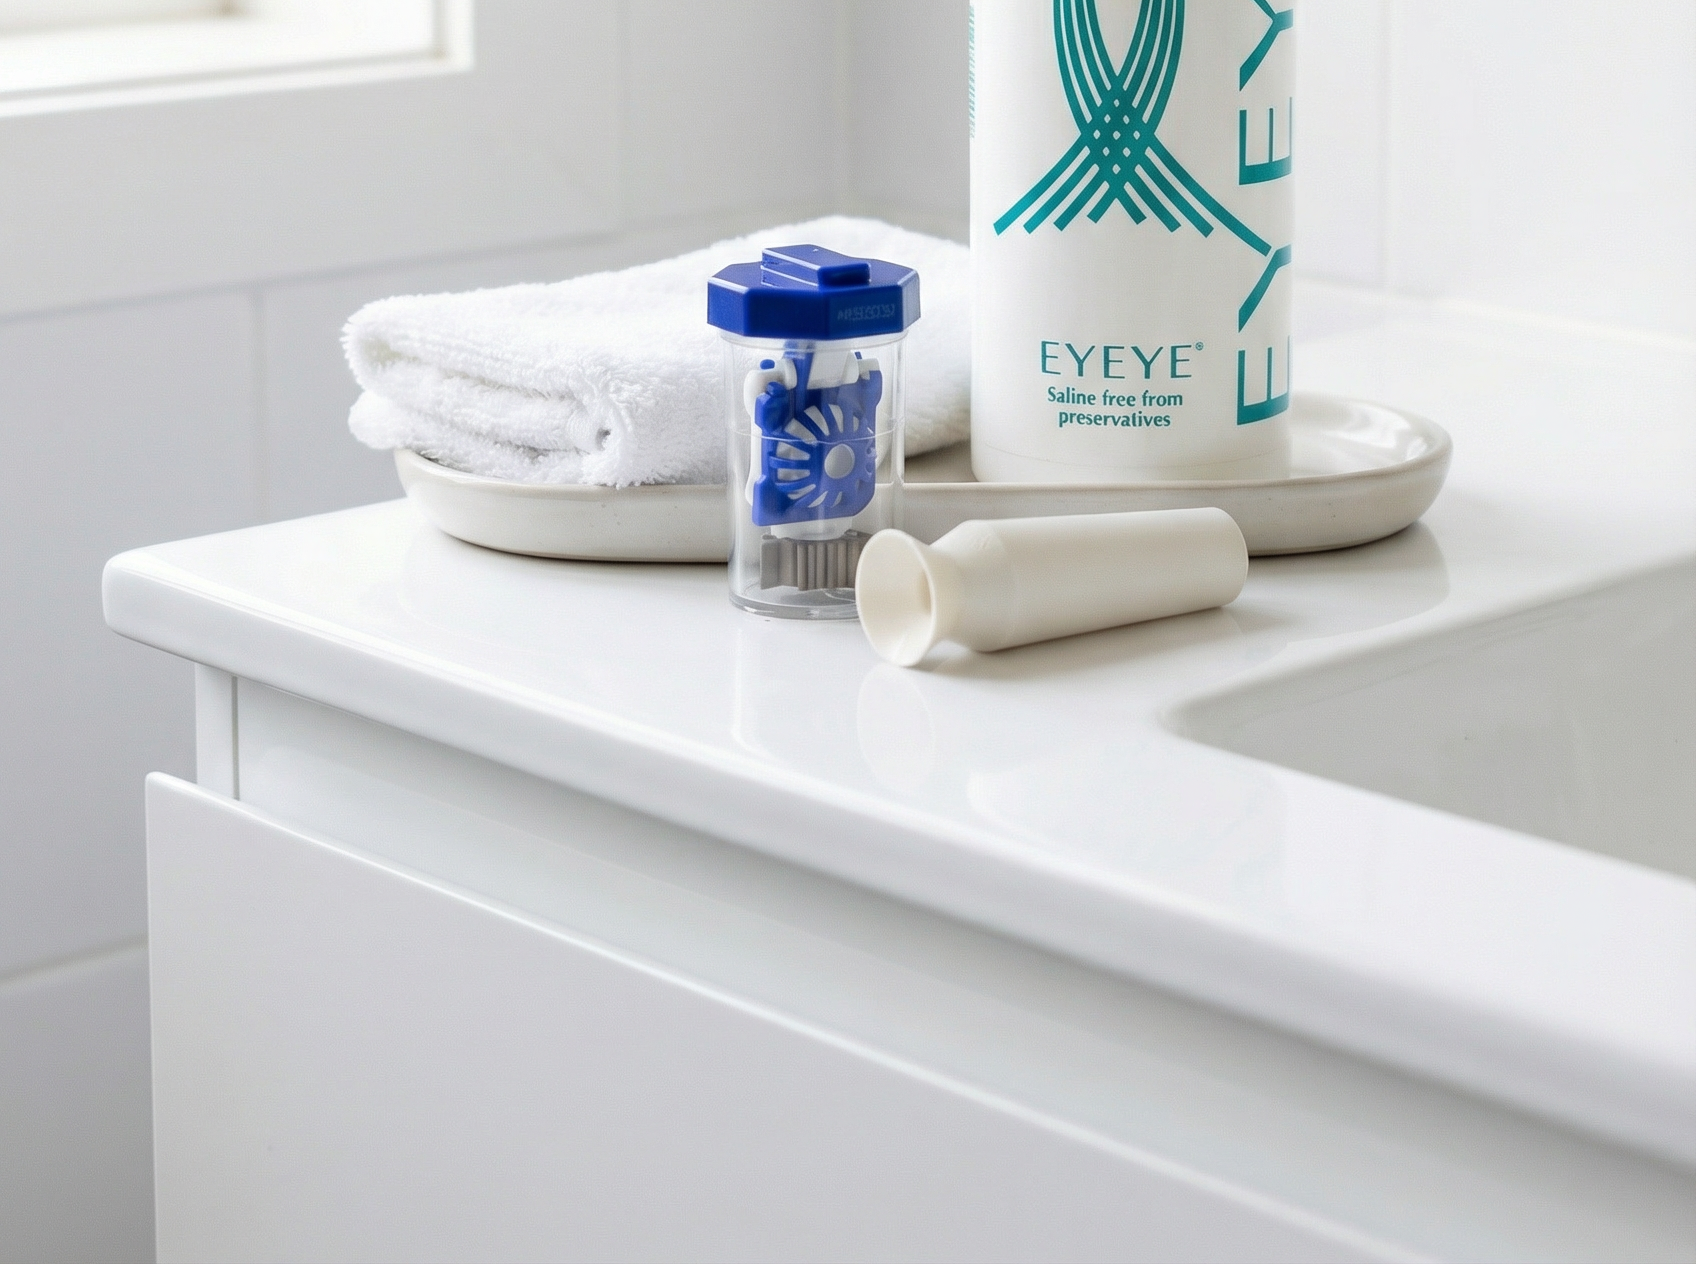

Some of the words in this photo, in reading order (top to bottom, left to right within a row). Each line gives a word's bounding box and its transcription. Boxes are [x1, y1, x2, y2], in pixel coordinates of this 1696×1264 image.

[1047, 385, 1097, 406] Saline
[1102, 389, 1137, 407] free
[1141, 389, 1183, 407] from
[1058, 410, 1172, 428] preservatives
